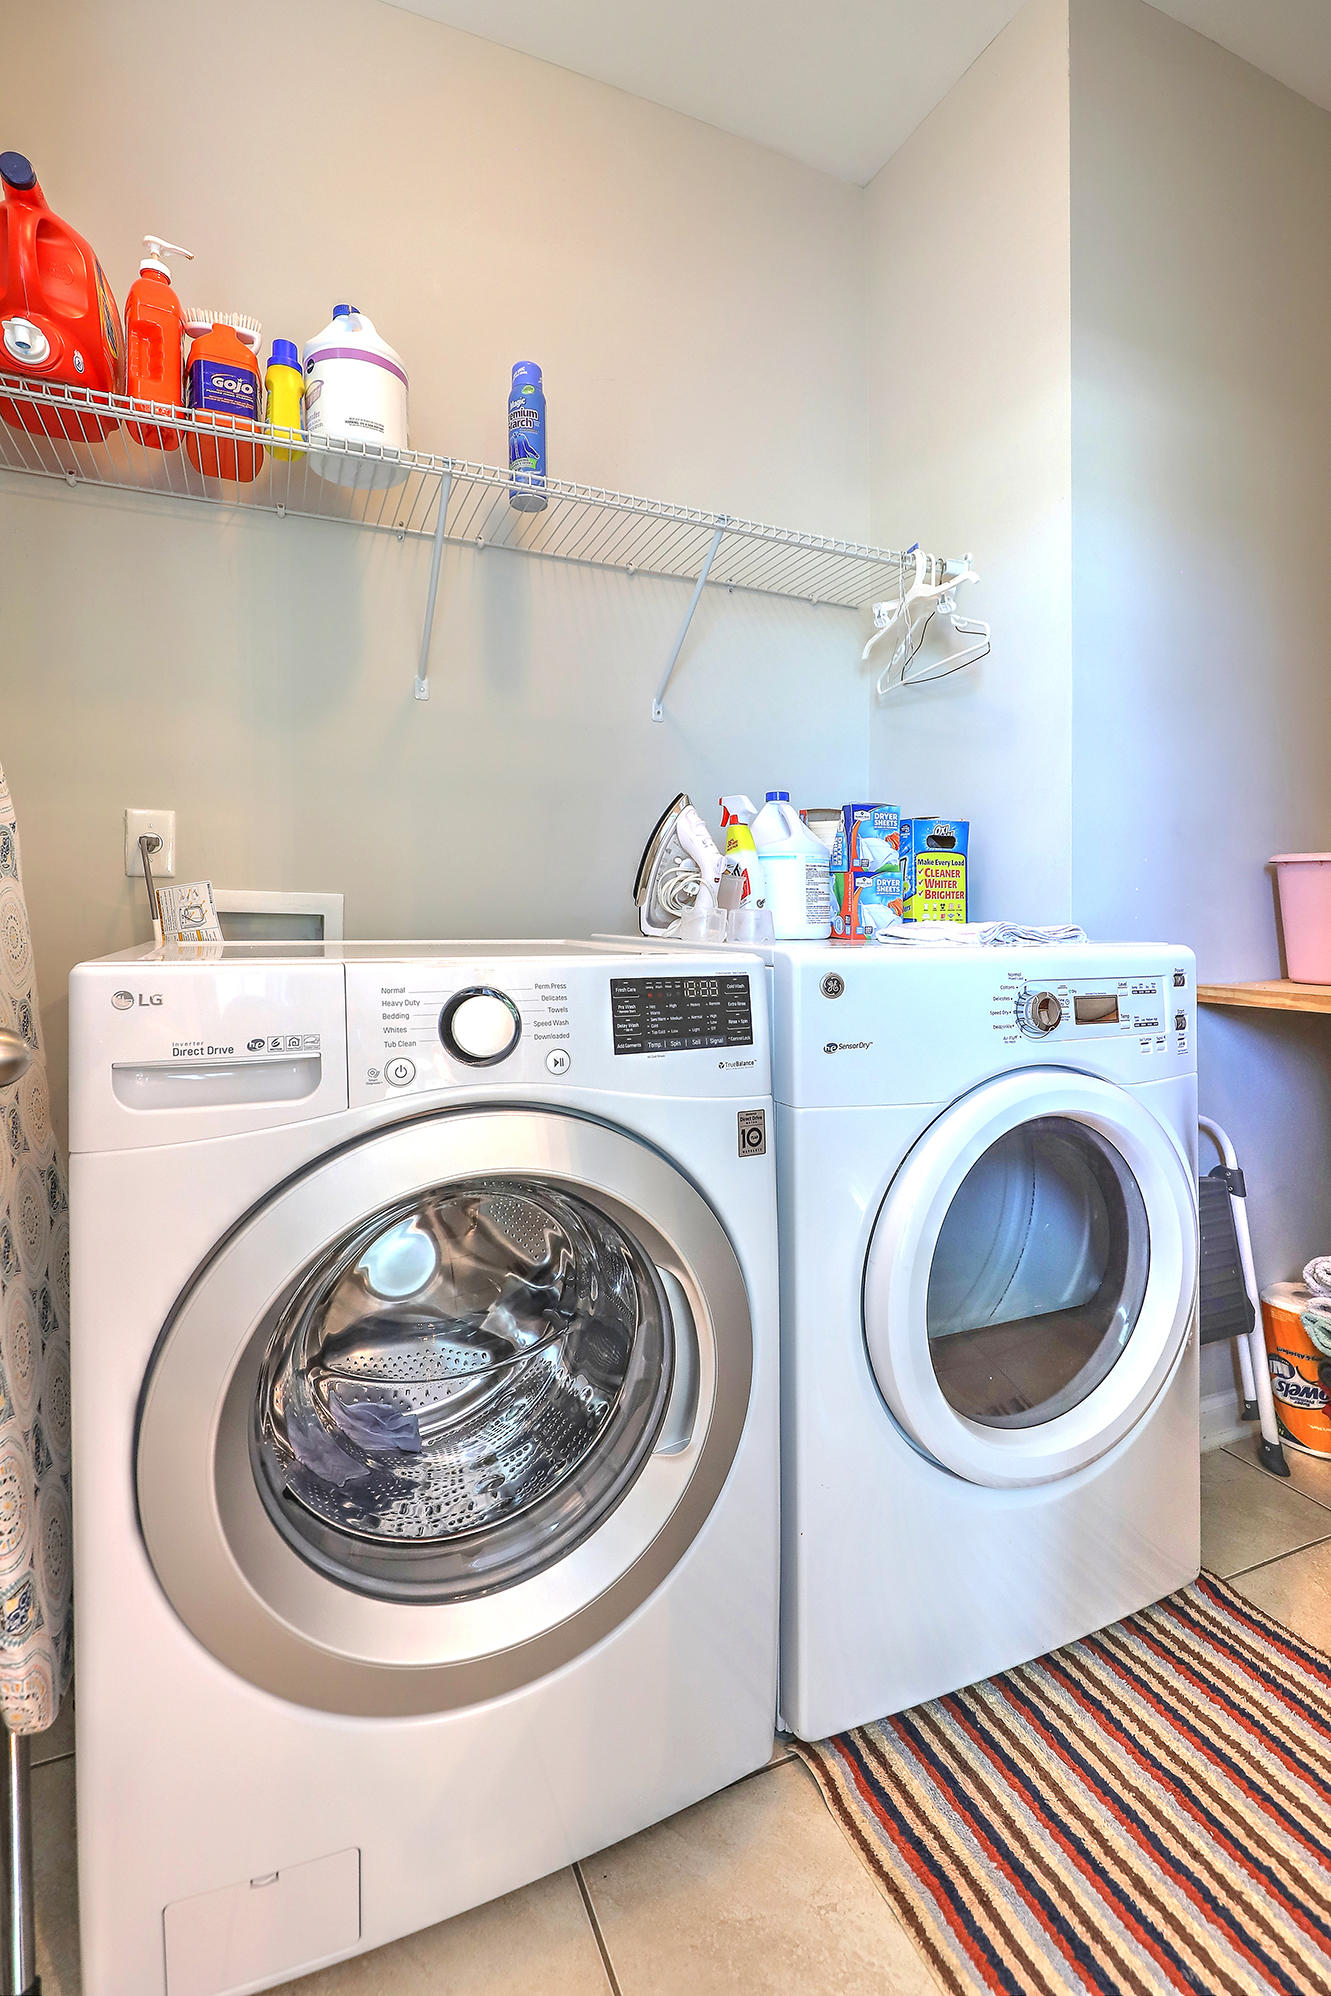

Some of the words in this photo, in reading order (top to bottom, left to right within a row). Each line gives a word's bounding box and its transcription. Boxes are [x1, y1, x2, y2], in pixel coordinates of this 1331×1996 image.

[212, 376, 254, 395] GOJO
[508, 406, 538, 420] emium
[508, 417, 532, 430] tarch
[874, 812, 898, 820] DRYER
[935, 859, 951, 867] Every
[924, 868, 960, 878] CLEANER
[924, 879, 958, 888] WHITER
[924, 890, 964, 900] BRIGHTER
[138, 993, 163, 1006] LG
[172, 1048, 204, 1057] Direct
[207, 1046, 234, 1055] Drive
[741, 1127, 762, 1148] 10
[1276, 1380, 1328, 1400] owels
